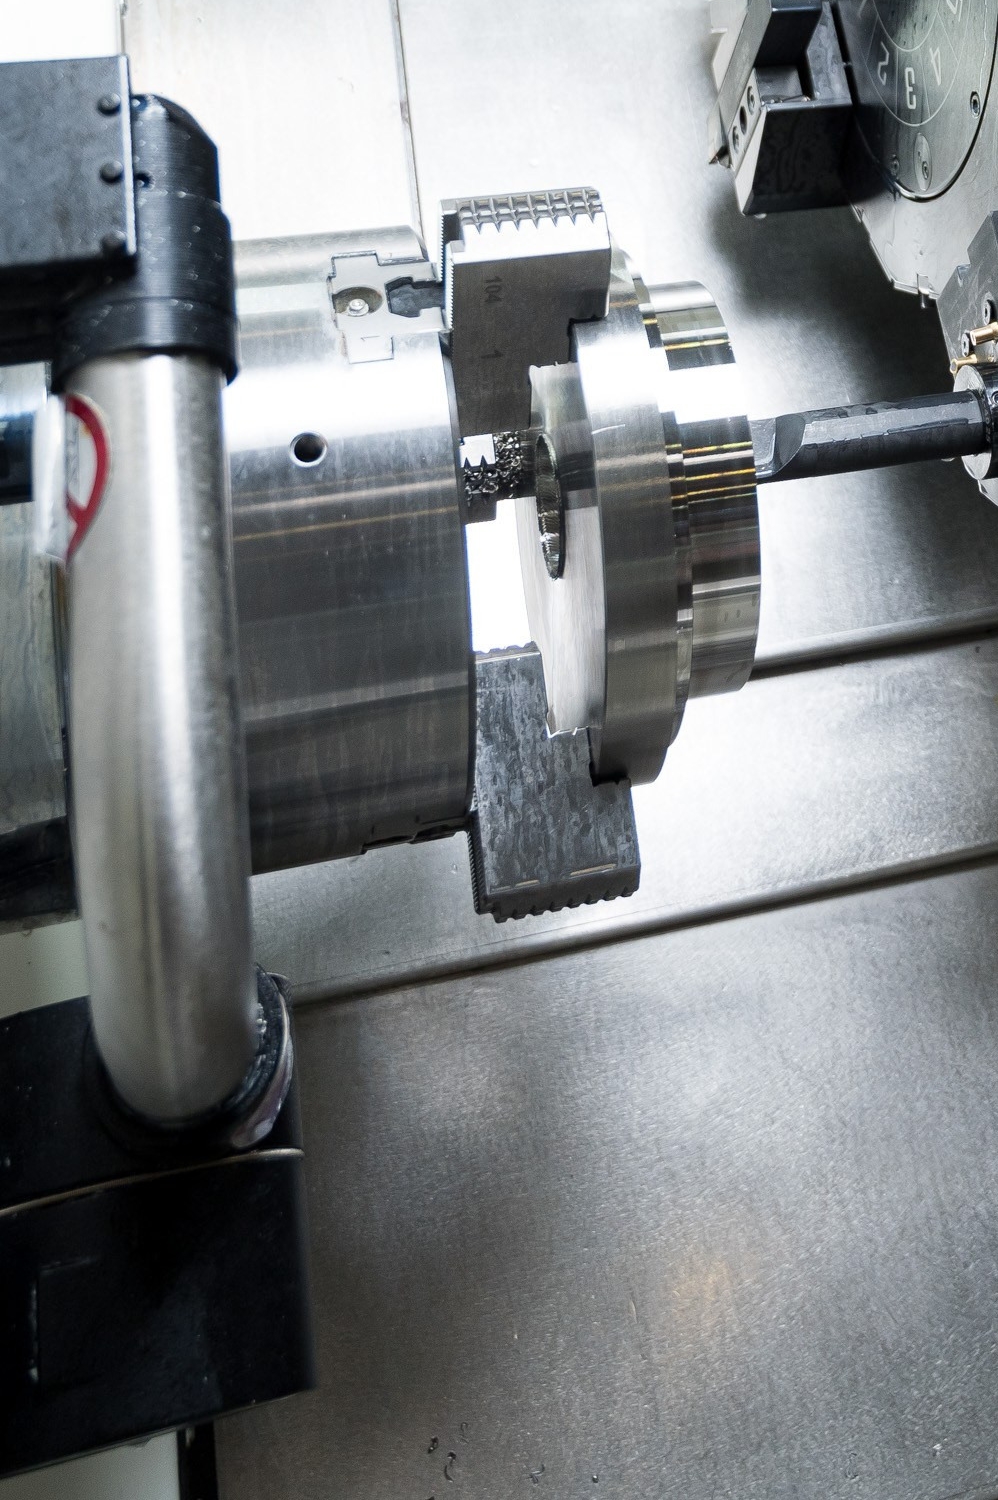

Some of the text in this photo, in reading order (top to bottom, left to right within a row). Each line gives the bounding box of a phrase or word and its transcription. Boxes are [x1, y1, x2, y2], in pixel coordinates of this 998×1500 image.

[877, 41, 890, 86] 2
[928, 46, 941, 86] 4
[904, 66, 917, 110] 3
[484, 276, 502, 303] 104
